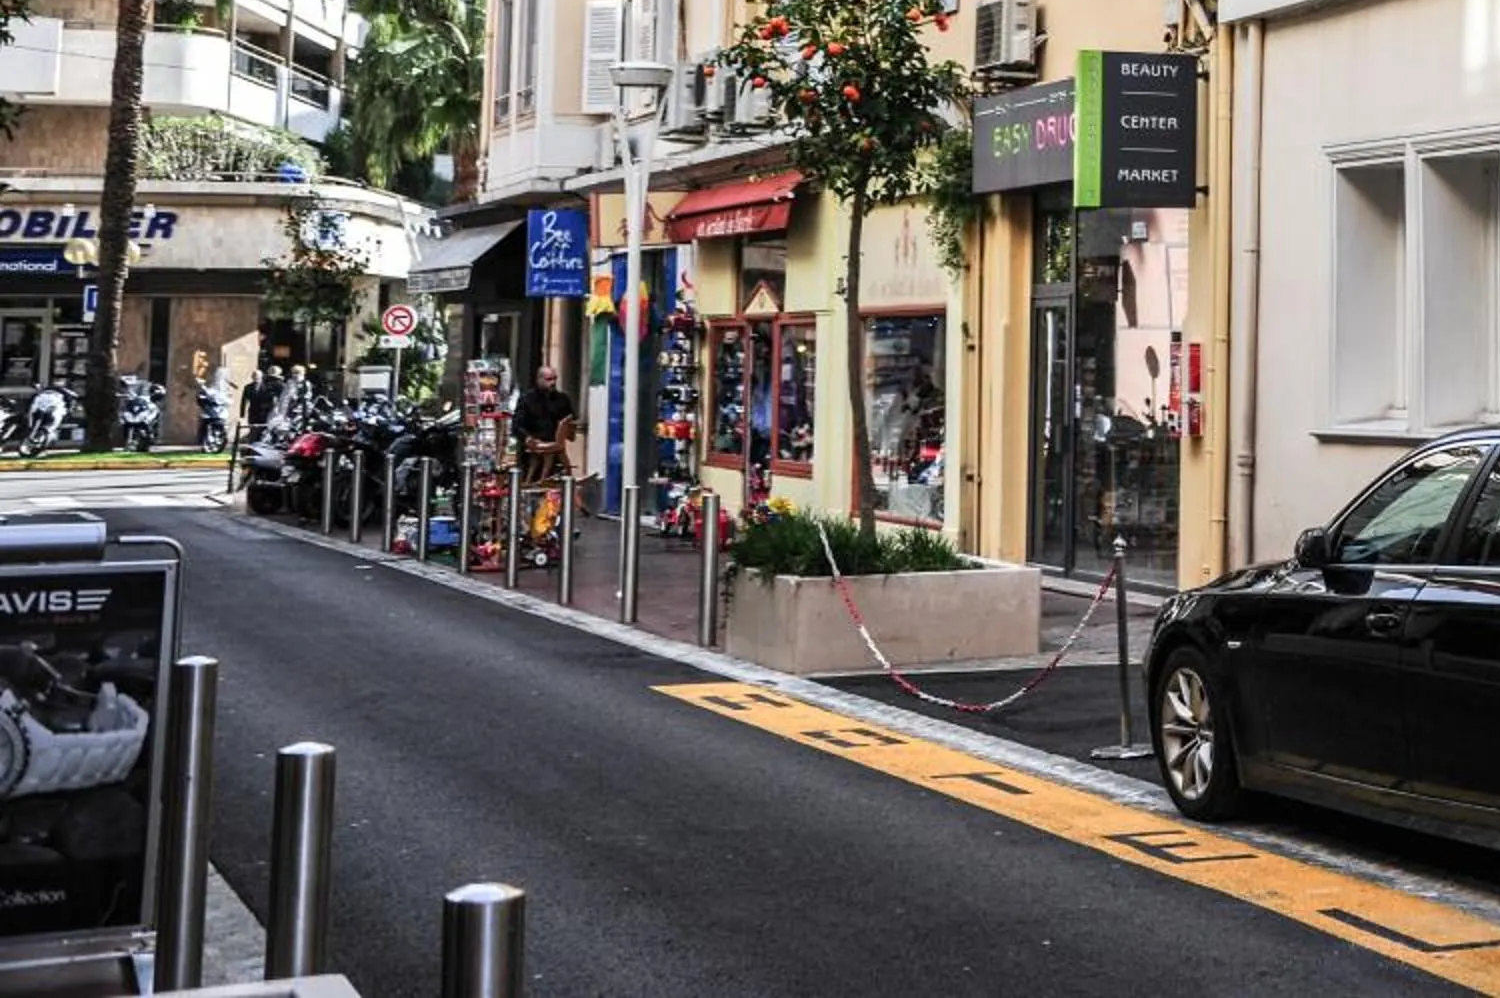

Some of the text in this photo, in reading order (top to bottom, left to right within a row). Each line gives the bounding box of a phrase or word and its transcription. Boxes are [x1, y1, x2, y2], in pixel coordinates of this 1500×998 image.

[1120, 62, 1179, 79] BEAUTY
[1120, 115, 1178, 130] CENTER
[1117, 168, 1179, 183] MARKET
[0, 211, 178, 239] OBILER
